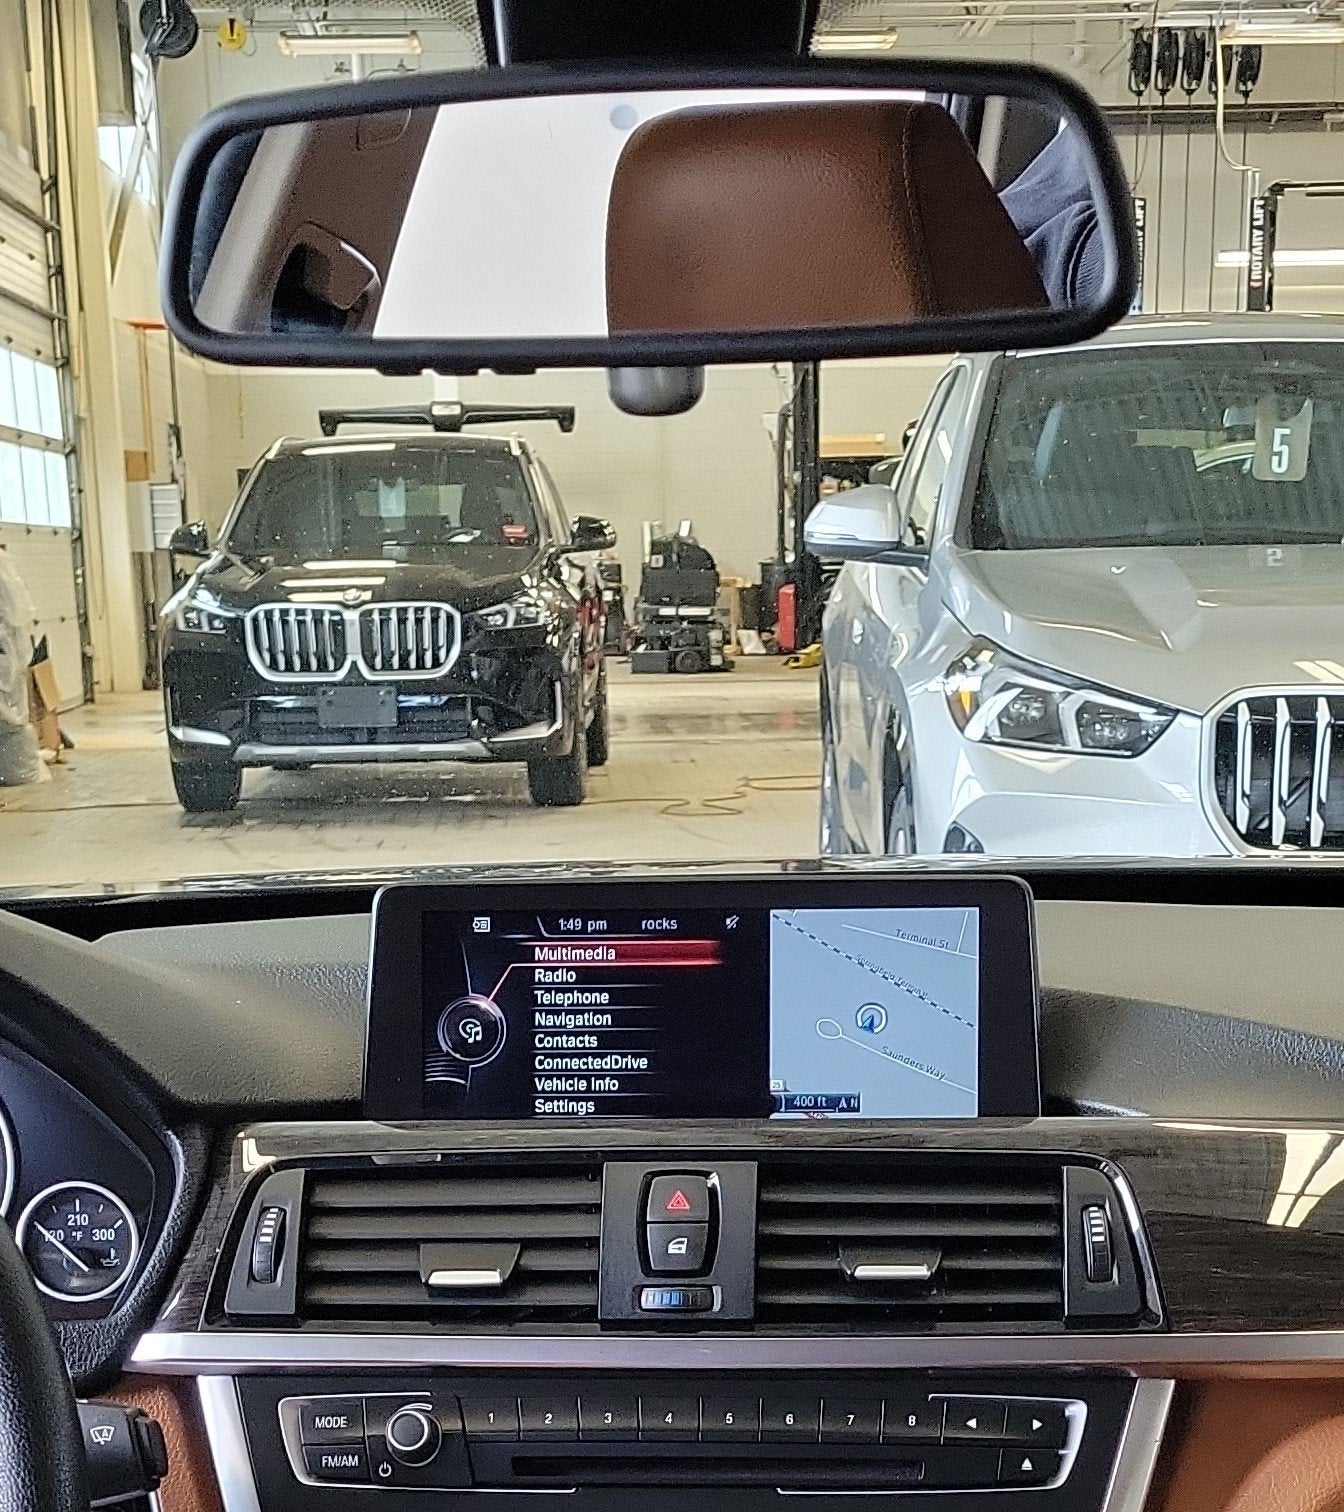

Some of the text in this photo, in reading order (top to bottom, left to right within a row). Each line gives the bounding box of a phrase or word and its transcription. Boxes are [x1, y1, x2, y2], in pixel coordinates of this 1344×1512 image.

[1271, 427, 1291, 474] 5
[558, 918, 607, 932] 1:49 pm
[641, 918, 678, 930] rocks
[895, 928, 937, 947] Terminal
[534, 946, 616, 961] Multimedia
[534, 968, 576, 982] Radio
[534, 990, 610, 1007] Telephone
[534, 1012, 612, 1029] Navigation
[534, 1034, 598, 1048] Contacts
[534, 1055, 648, 1070] ConnectedDrive
[882, 1045, 946, 1081] Saunders Way
[534, 1076, 587, 1092] Vehicle
[534, 1098, 595, 1115] Settings
[793, 1095, 826, 1107] 400 ft
[67, 1213, 89, 1226] 210
[91, 1228, 115, 1241] 300
[315, 1416, 348, 1429] MODE
[488, 1412, 495, 1424] 1
[544, 1413, 553, 1424] 2
[604, 1412, 612, 1424] 3
[664, 1412, 673, 1424] 4
[725, 1412, 733, 1425] 5
[785, 1413, 794, 1425] 6
[846, 1414, 855, 1426] 7
[908, 1415, 917, 1426] 8
[322, 1454, 359, 1468] FM/AM
